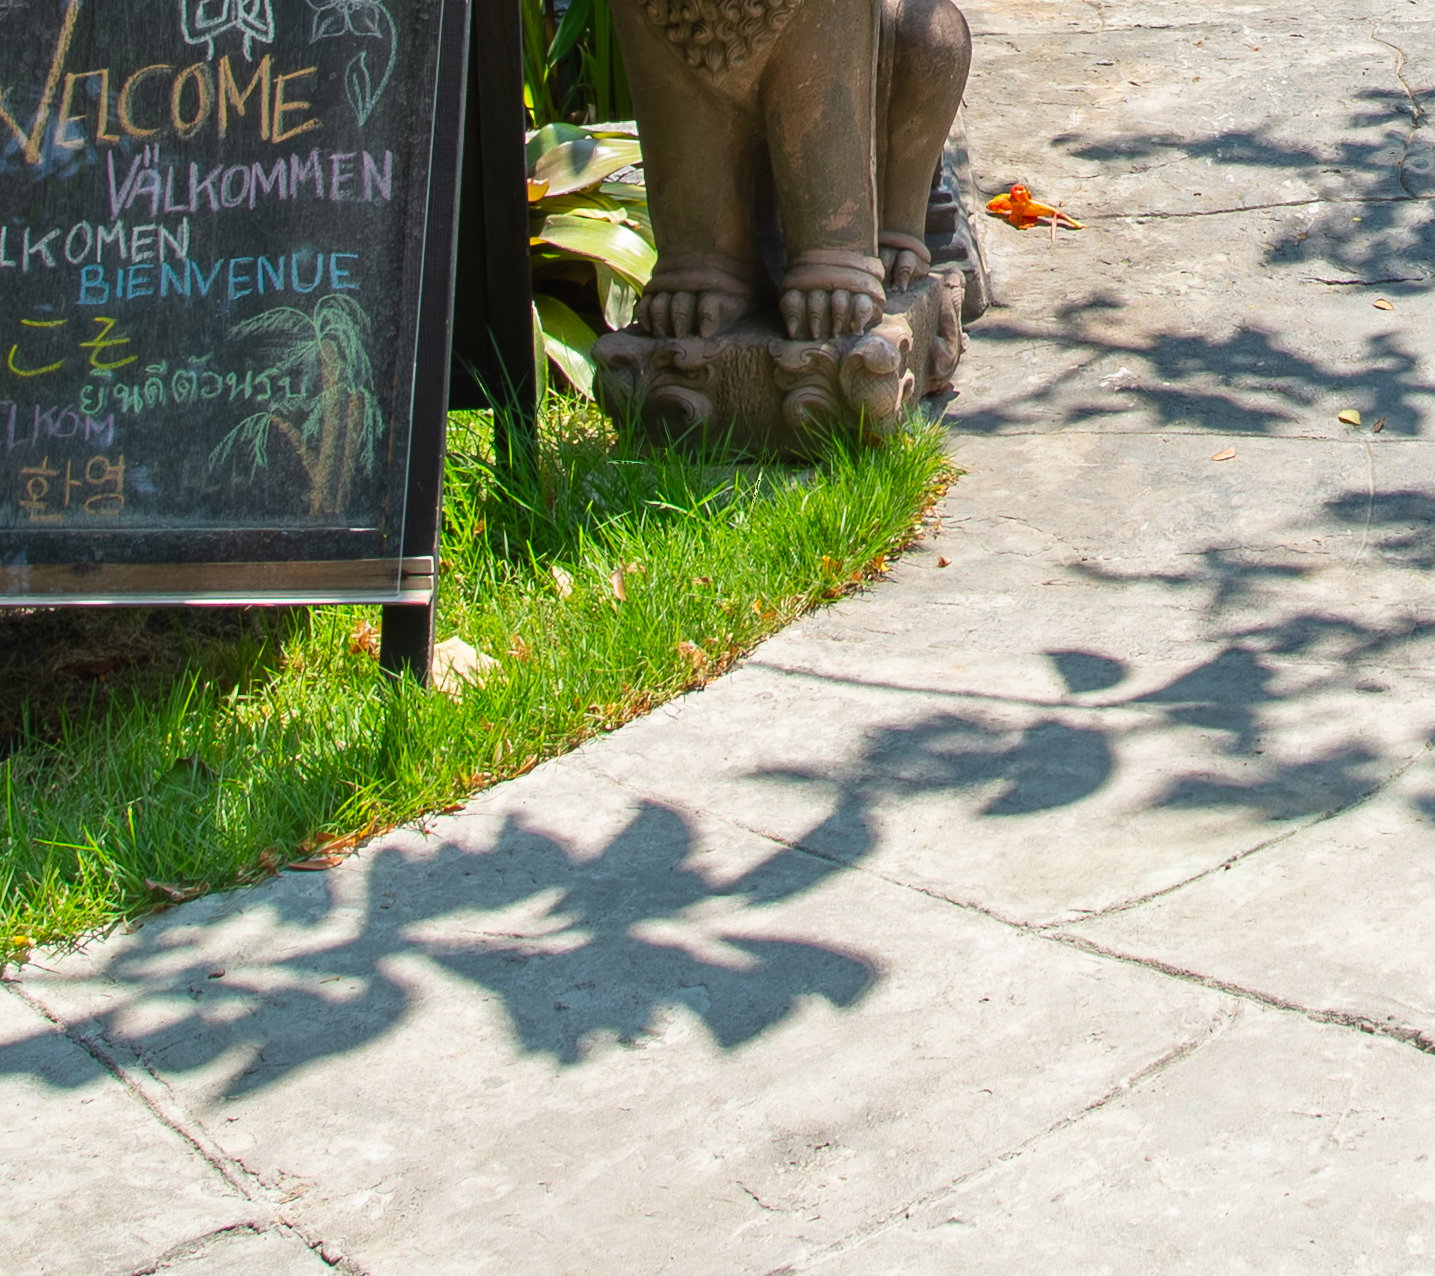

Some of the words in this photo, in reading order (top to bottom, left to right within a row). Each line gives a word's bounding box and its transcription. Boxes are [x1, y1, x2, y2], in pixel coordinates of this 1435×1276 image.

[108, 144, 392, 219] VÄLKOMMEN
[77, 253, 360, 305] BIENVENUE
[19, 455, 125, 523] 환영
